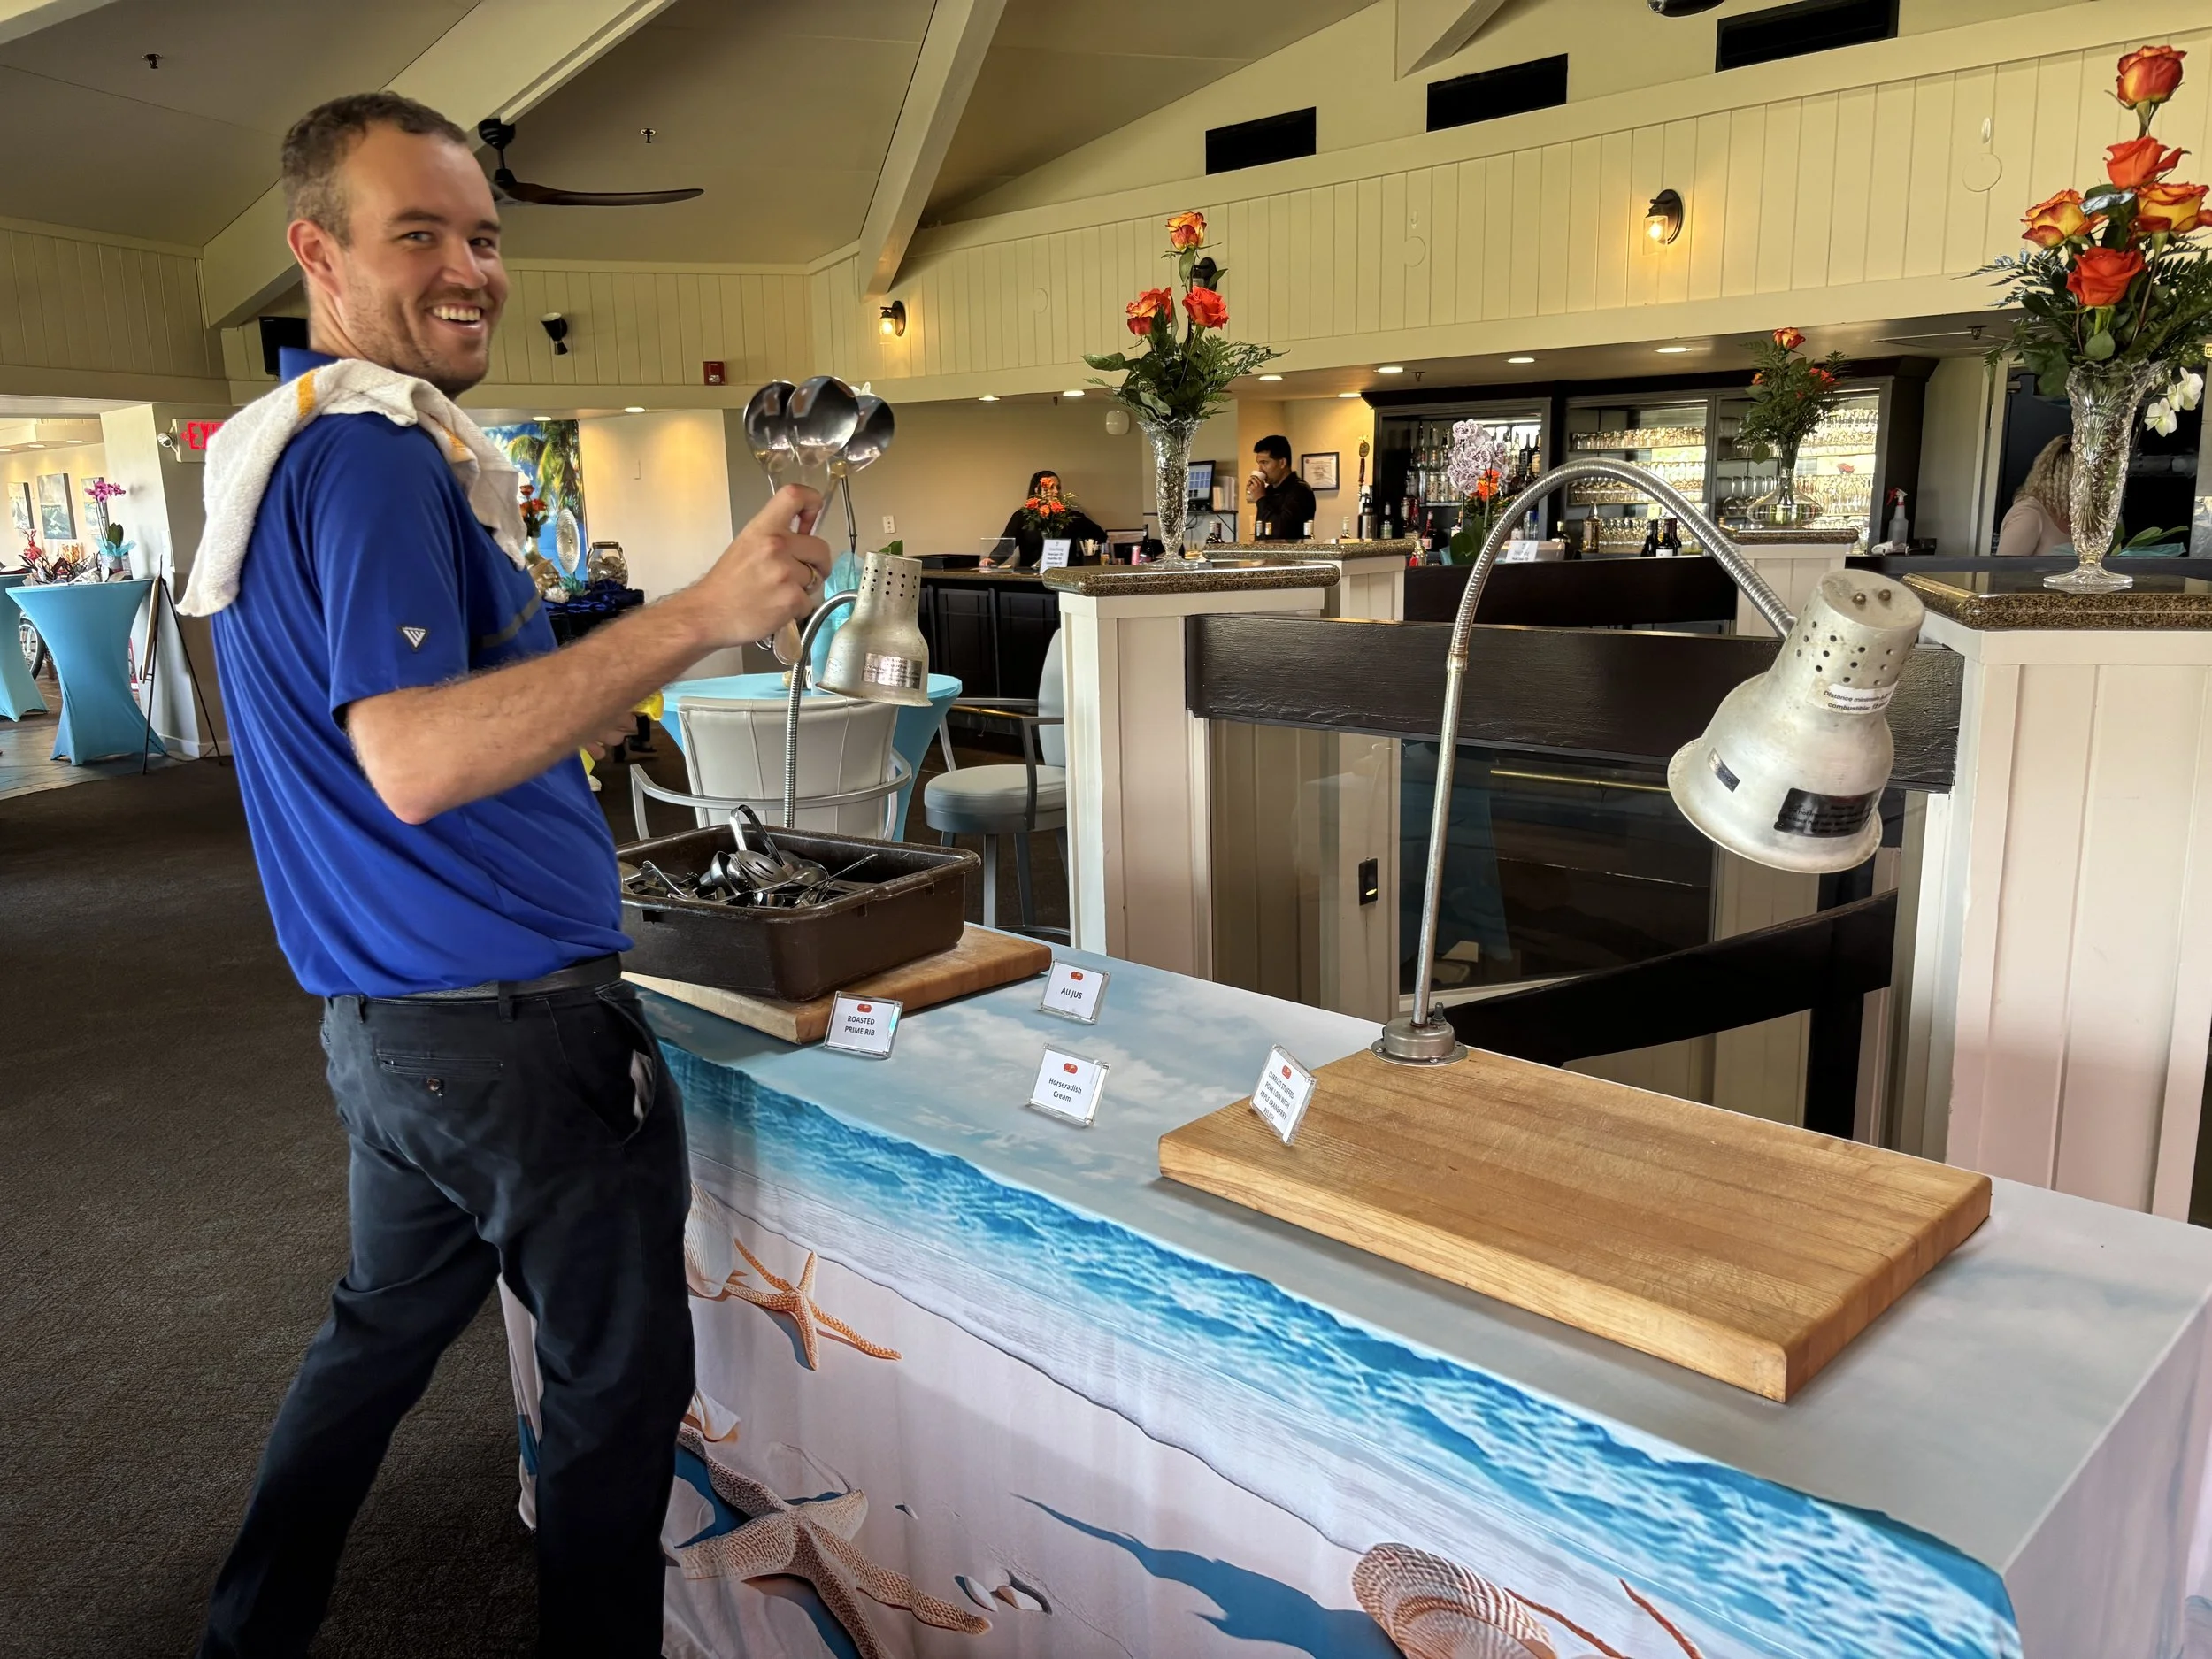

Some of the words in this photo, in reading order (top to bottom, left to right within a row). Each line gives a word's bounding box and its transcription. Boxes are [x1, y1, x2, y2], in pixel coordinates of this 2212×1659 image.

[188, 422, 225, 449] EX
[1061, 987, 1071, 996] AU
[1070, 990, 1082, 999] JUS
[847, 1015, 875, 1025] ROASTED
[844, 1025, 864, 1034] PRIME
[1048, 1077, 1082, 1094] Horseradish
[1281, 1082, 1295, 1099] STUFFED
[1053, 1090, 1071, 1102] Cream
[1264, 1081, 1273, 1094] PORK
[1272, 1088, 1282, 1101] LOIN
[1281, 1097, 1290, 1109] WITH
[1260, 1090, 1271, 1102] APPLE
[1268, 1099, 1286, 1120] CRANBERRY
